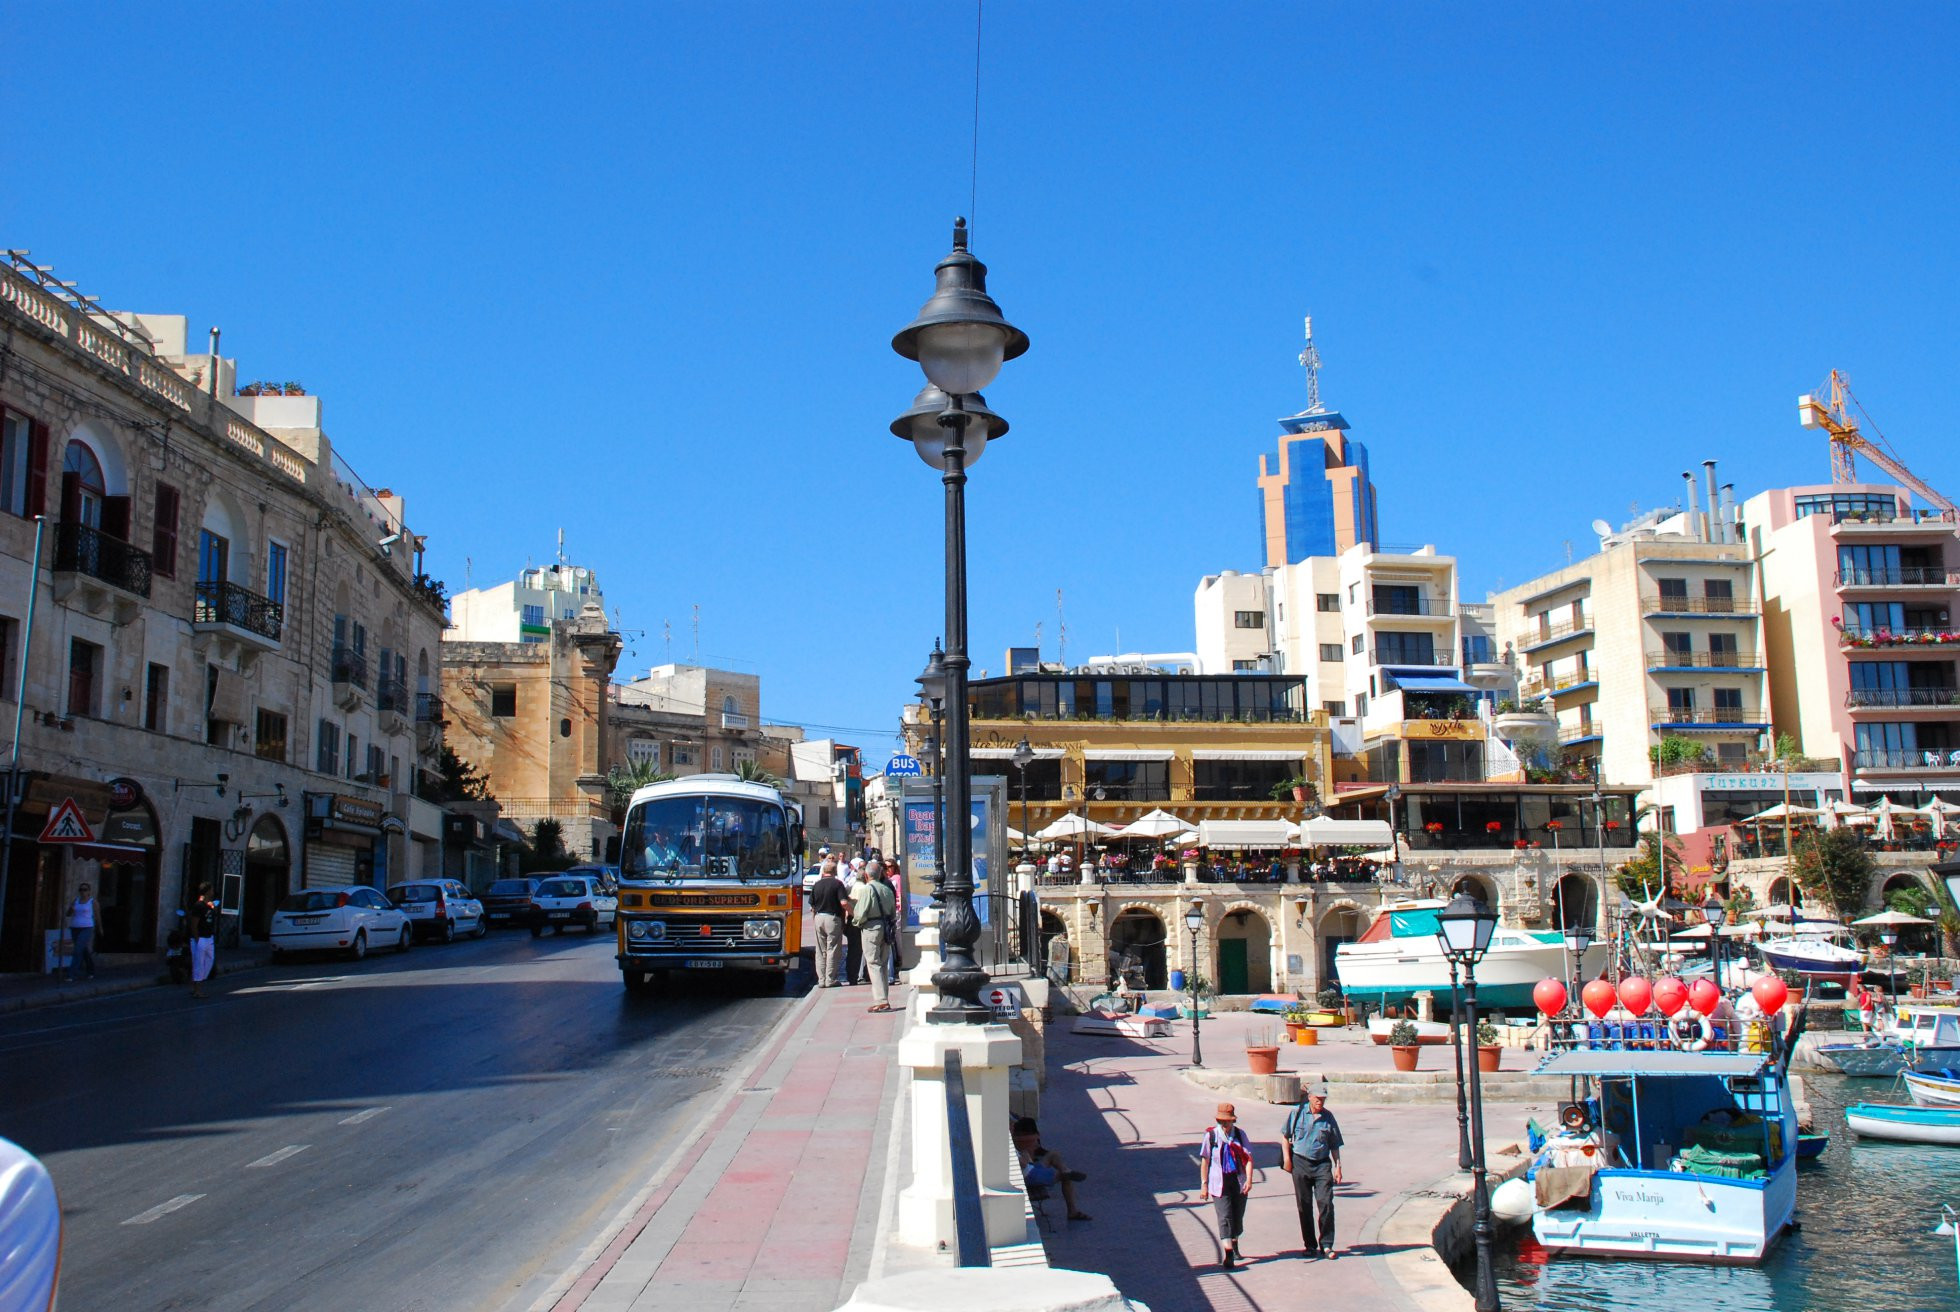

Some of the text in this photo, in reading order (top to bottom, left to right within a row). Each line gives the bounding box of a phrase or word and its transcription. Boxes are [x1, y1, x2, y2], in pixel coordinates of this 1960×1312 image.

[892, 758, 915, 769] BUS
[710, 859, 729, 875] 66
[1615, 1190, 1664, 1206] Viva Marija
